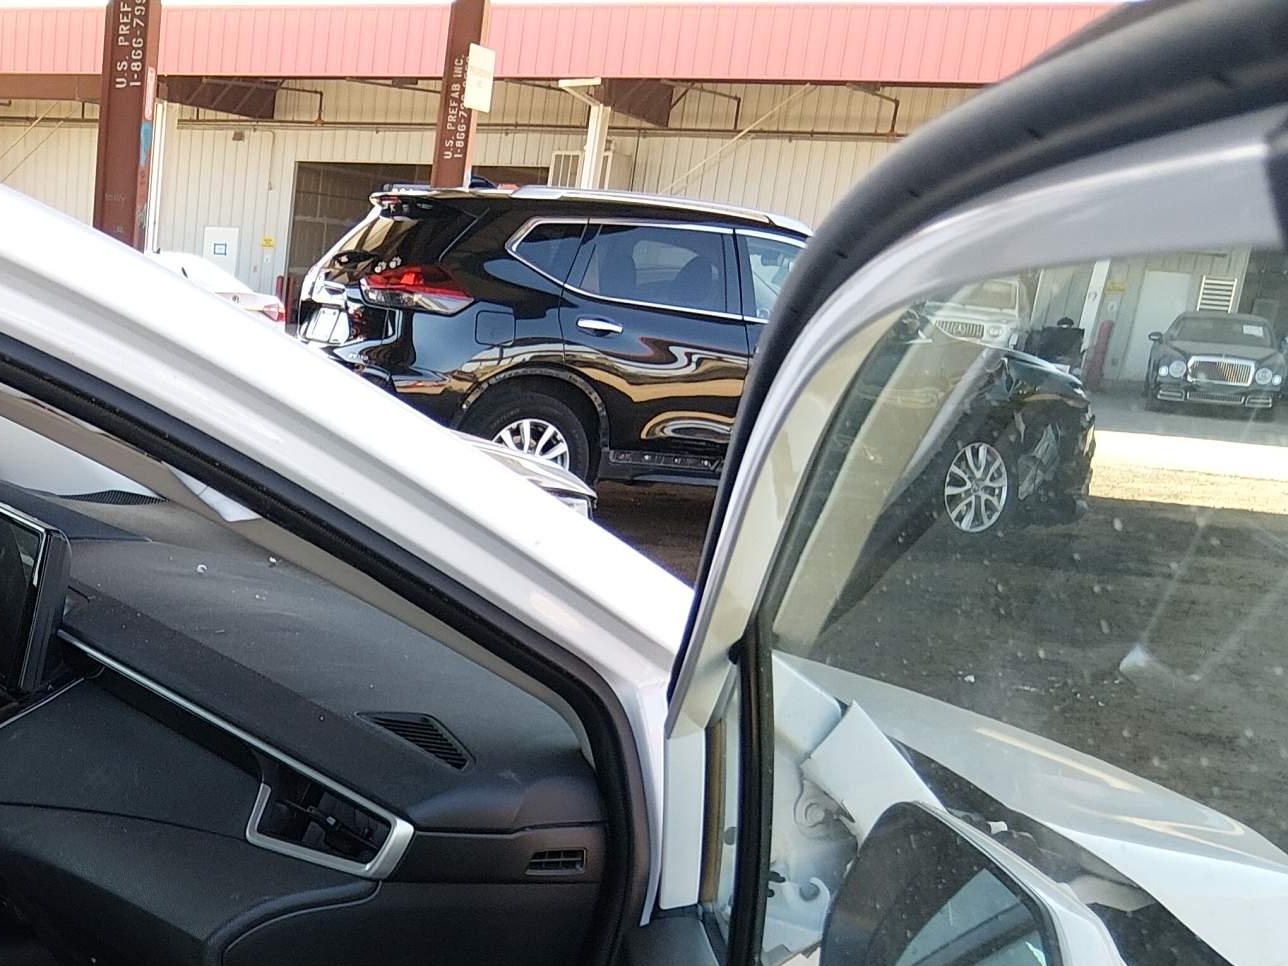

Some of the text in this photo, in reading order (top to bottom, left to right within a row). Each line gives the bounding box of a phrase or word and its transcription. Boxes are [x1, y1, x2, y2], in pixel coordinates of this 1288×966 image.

[115, 55, 129, 89] U.S.
[443, 54, 465, 159] U.S. PREFAB INC.
